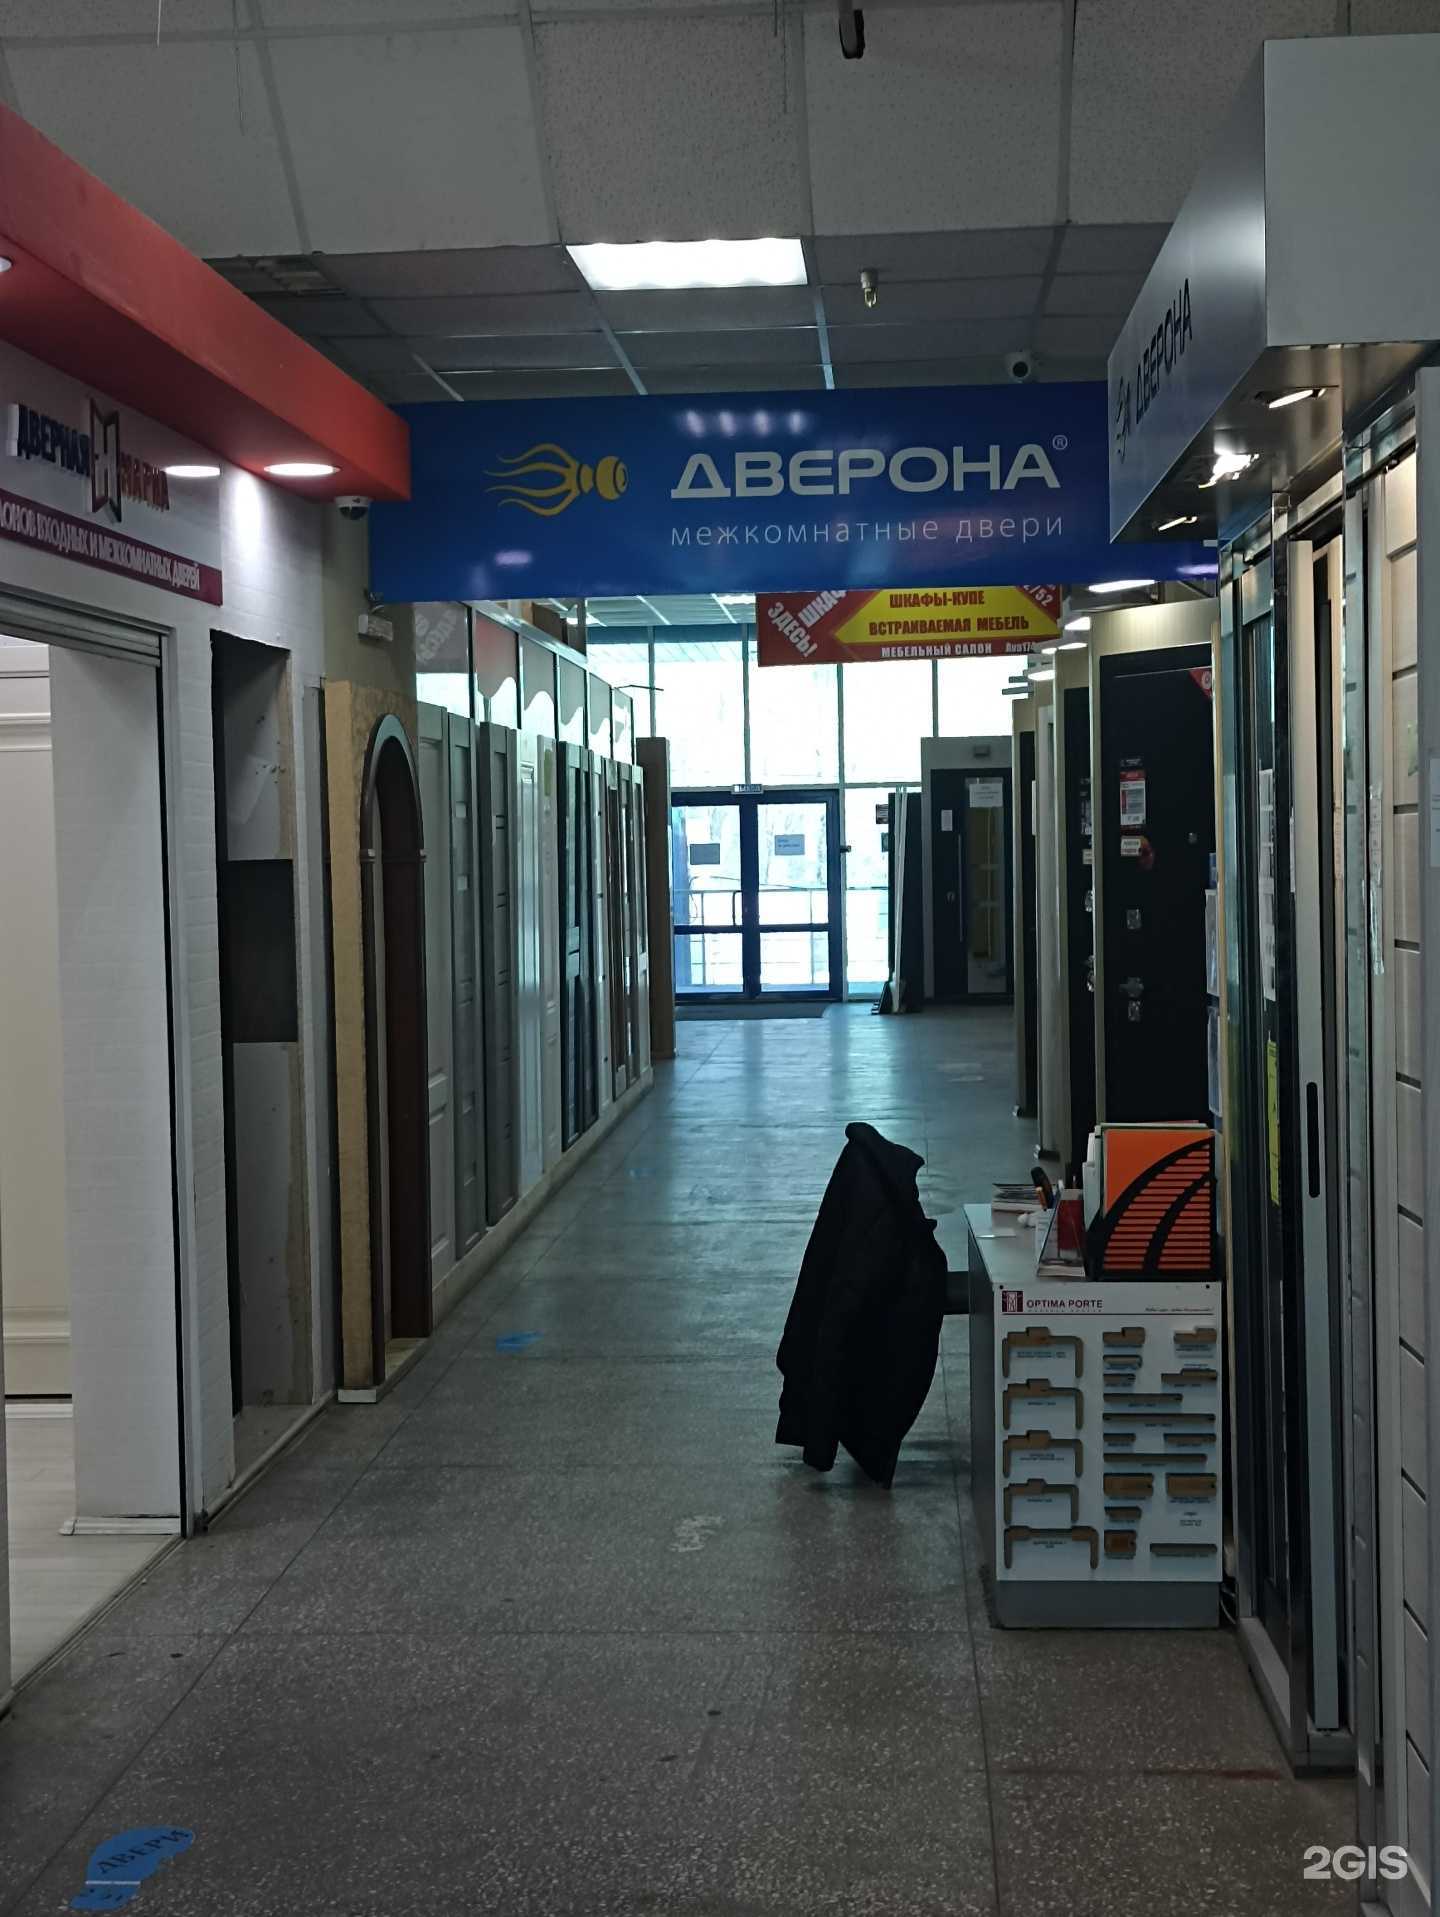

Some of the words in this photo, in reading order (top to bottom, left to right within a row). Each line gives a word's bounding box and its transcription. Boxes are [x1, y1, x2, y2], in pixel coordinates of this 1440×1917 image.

[1135, 277, 1193, 425] ДВЕРОНА
[671, 443, 1061, 499] ДВЕРОНА
[671, 519, 940, 546] межкомнатные
[955, 515, 1063, 543] двери
[37, 512, 89, 555] ВХОДНЫХ
[89, 531, 98, 557] И
[98, 533, 172, 582] МЕЖКОМНАТНЫХ
[171, 559, 200, 592] ДВЕРЕЙ
[889, 590, 985, 608] ШКАФЫ-КУПЕ
[768, 602, 818, 658] ЗДЕСЬ!
[869, 617, 971, 636] ВСТРАИВАЕМАЯ
[976, 615, 1030, 632] МЕБЕЛЬ
[881, 643, 951, 658] МЕБЕЛЬНЫЙ
[955, 643, 992, 655] САЛОН
[1026, 1299, 1066, 1309] OPTIMA
[1068, 1299, 1103, 1309] PORTE
